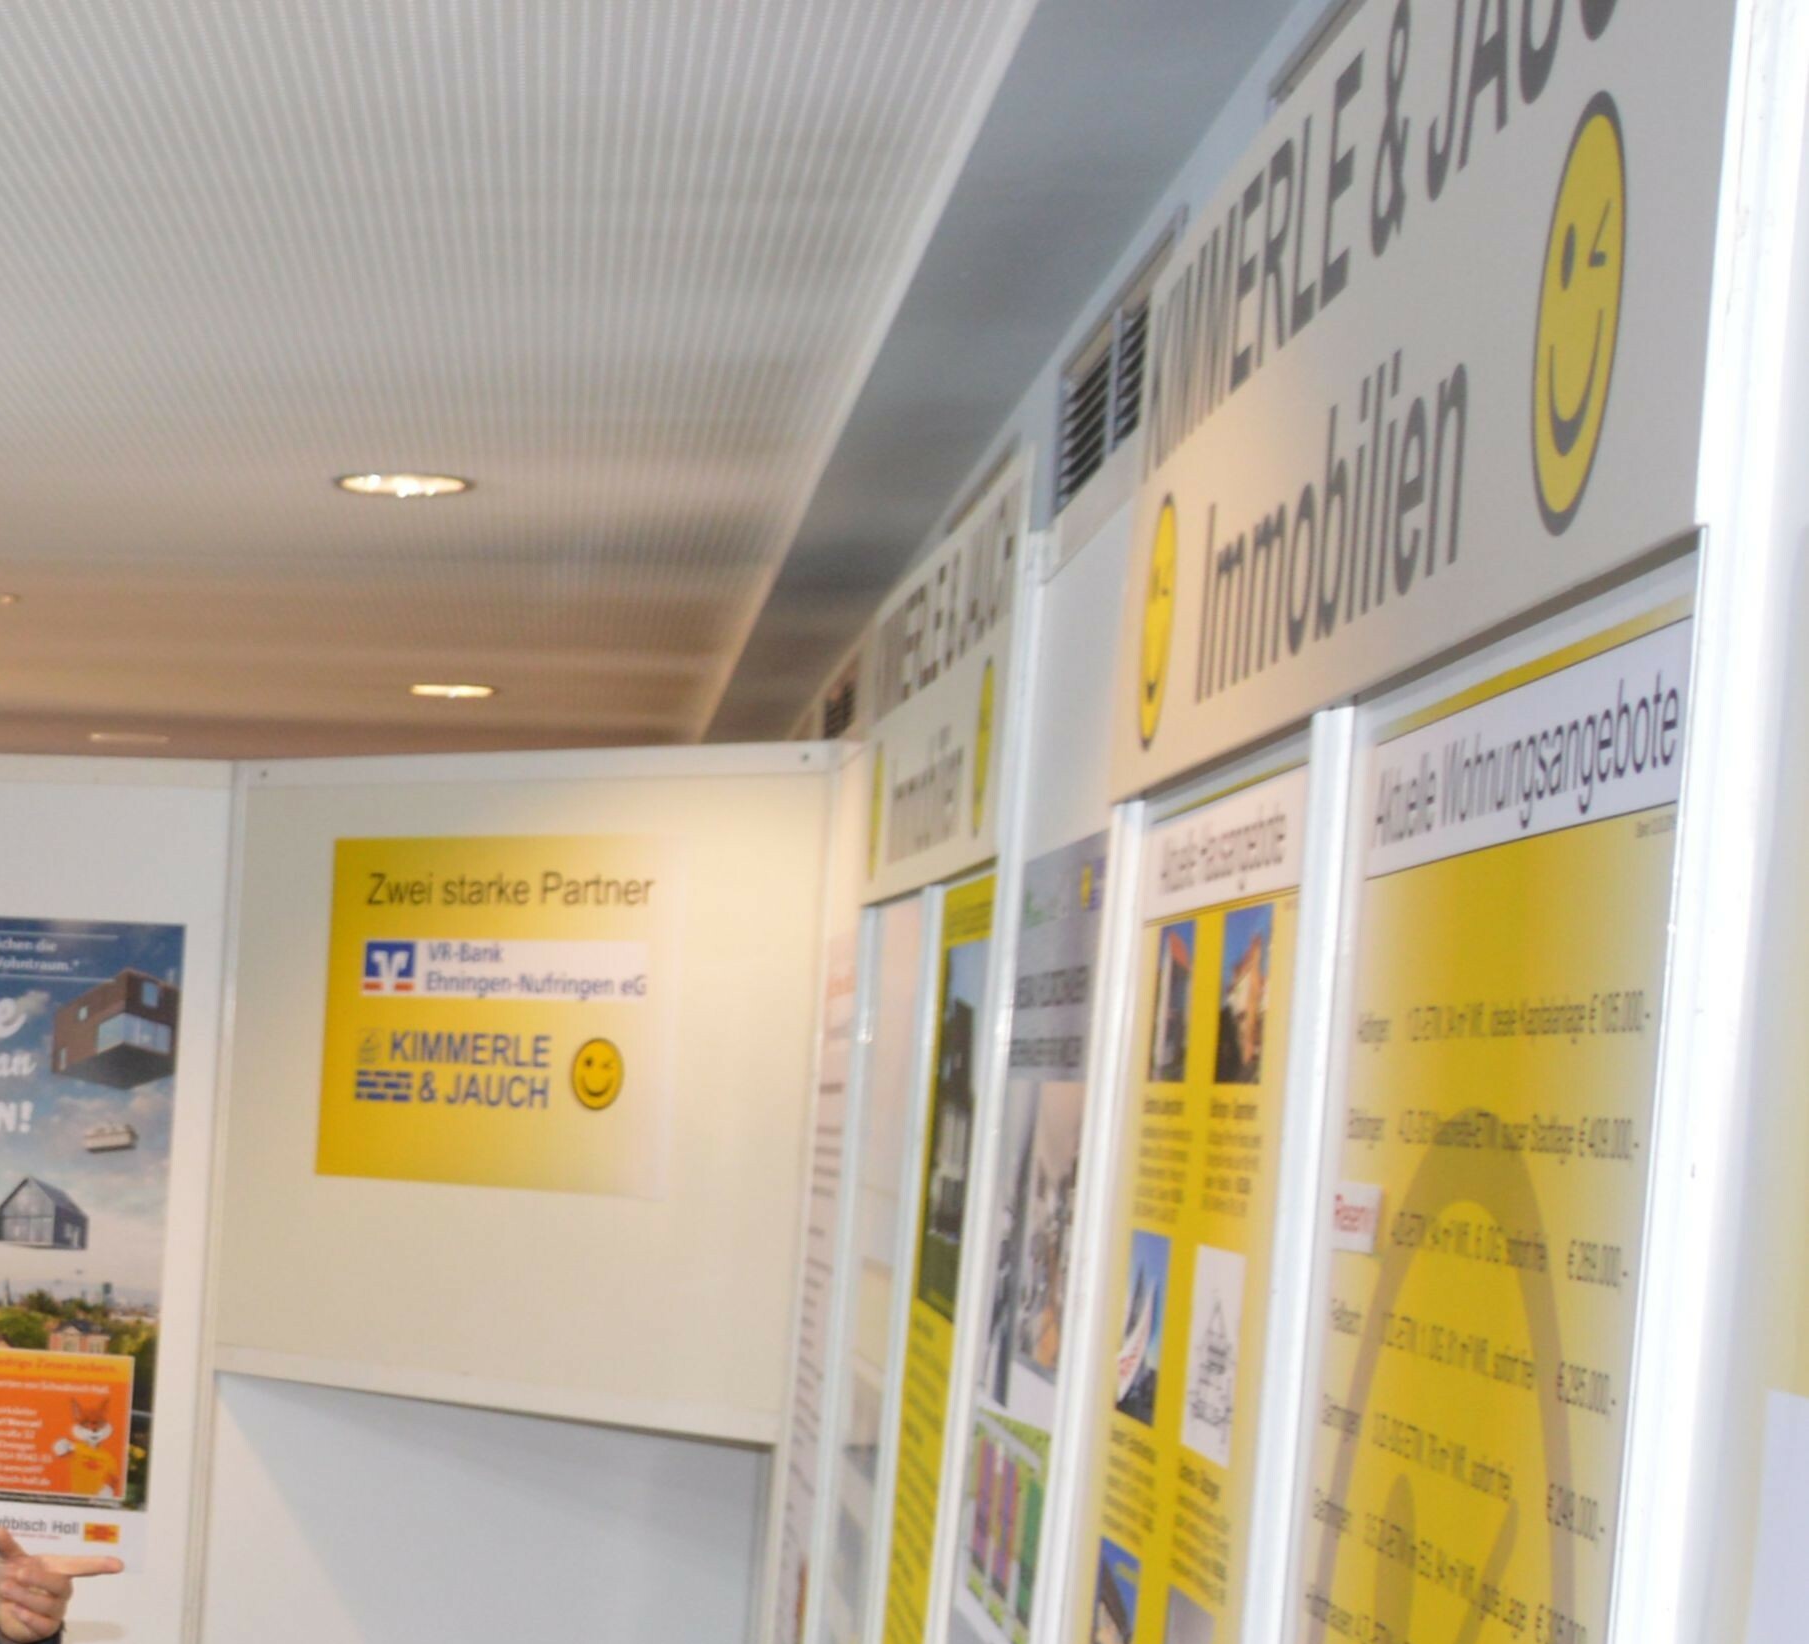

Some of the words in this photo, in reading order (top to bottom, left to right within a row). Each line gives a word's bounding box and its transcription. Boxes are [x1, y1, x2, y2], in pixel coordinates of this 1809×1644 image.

[1426, 0, 1619, 202] JA
[1195, 348, 1467, 704] Immobilien
[1438, 668, 1678, 828] Wohnungsangebote
[367, 871, 434, 906] Zwei
[442, 872, 530, 906] starke
[540, 869, 655, 906] Partner
[427, 941, 502, 964] VR-Bank
[425, 971, 615, 1001] Ehningen-Nufringen
[620, 975, 647, 997] eG
[389, 1031, 552, 1068] KIMMERLE
[419, 1071, 438, 1103] &
[444, 1074, 549, 1109] JAUCH
[52, 1519, 80, 1535] Hall
